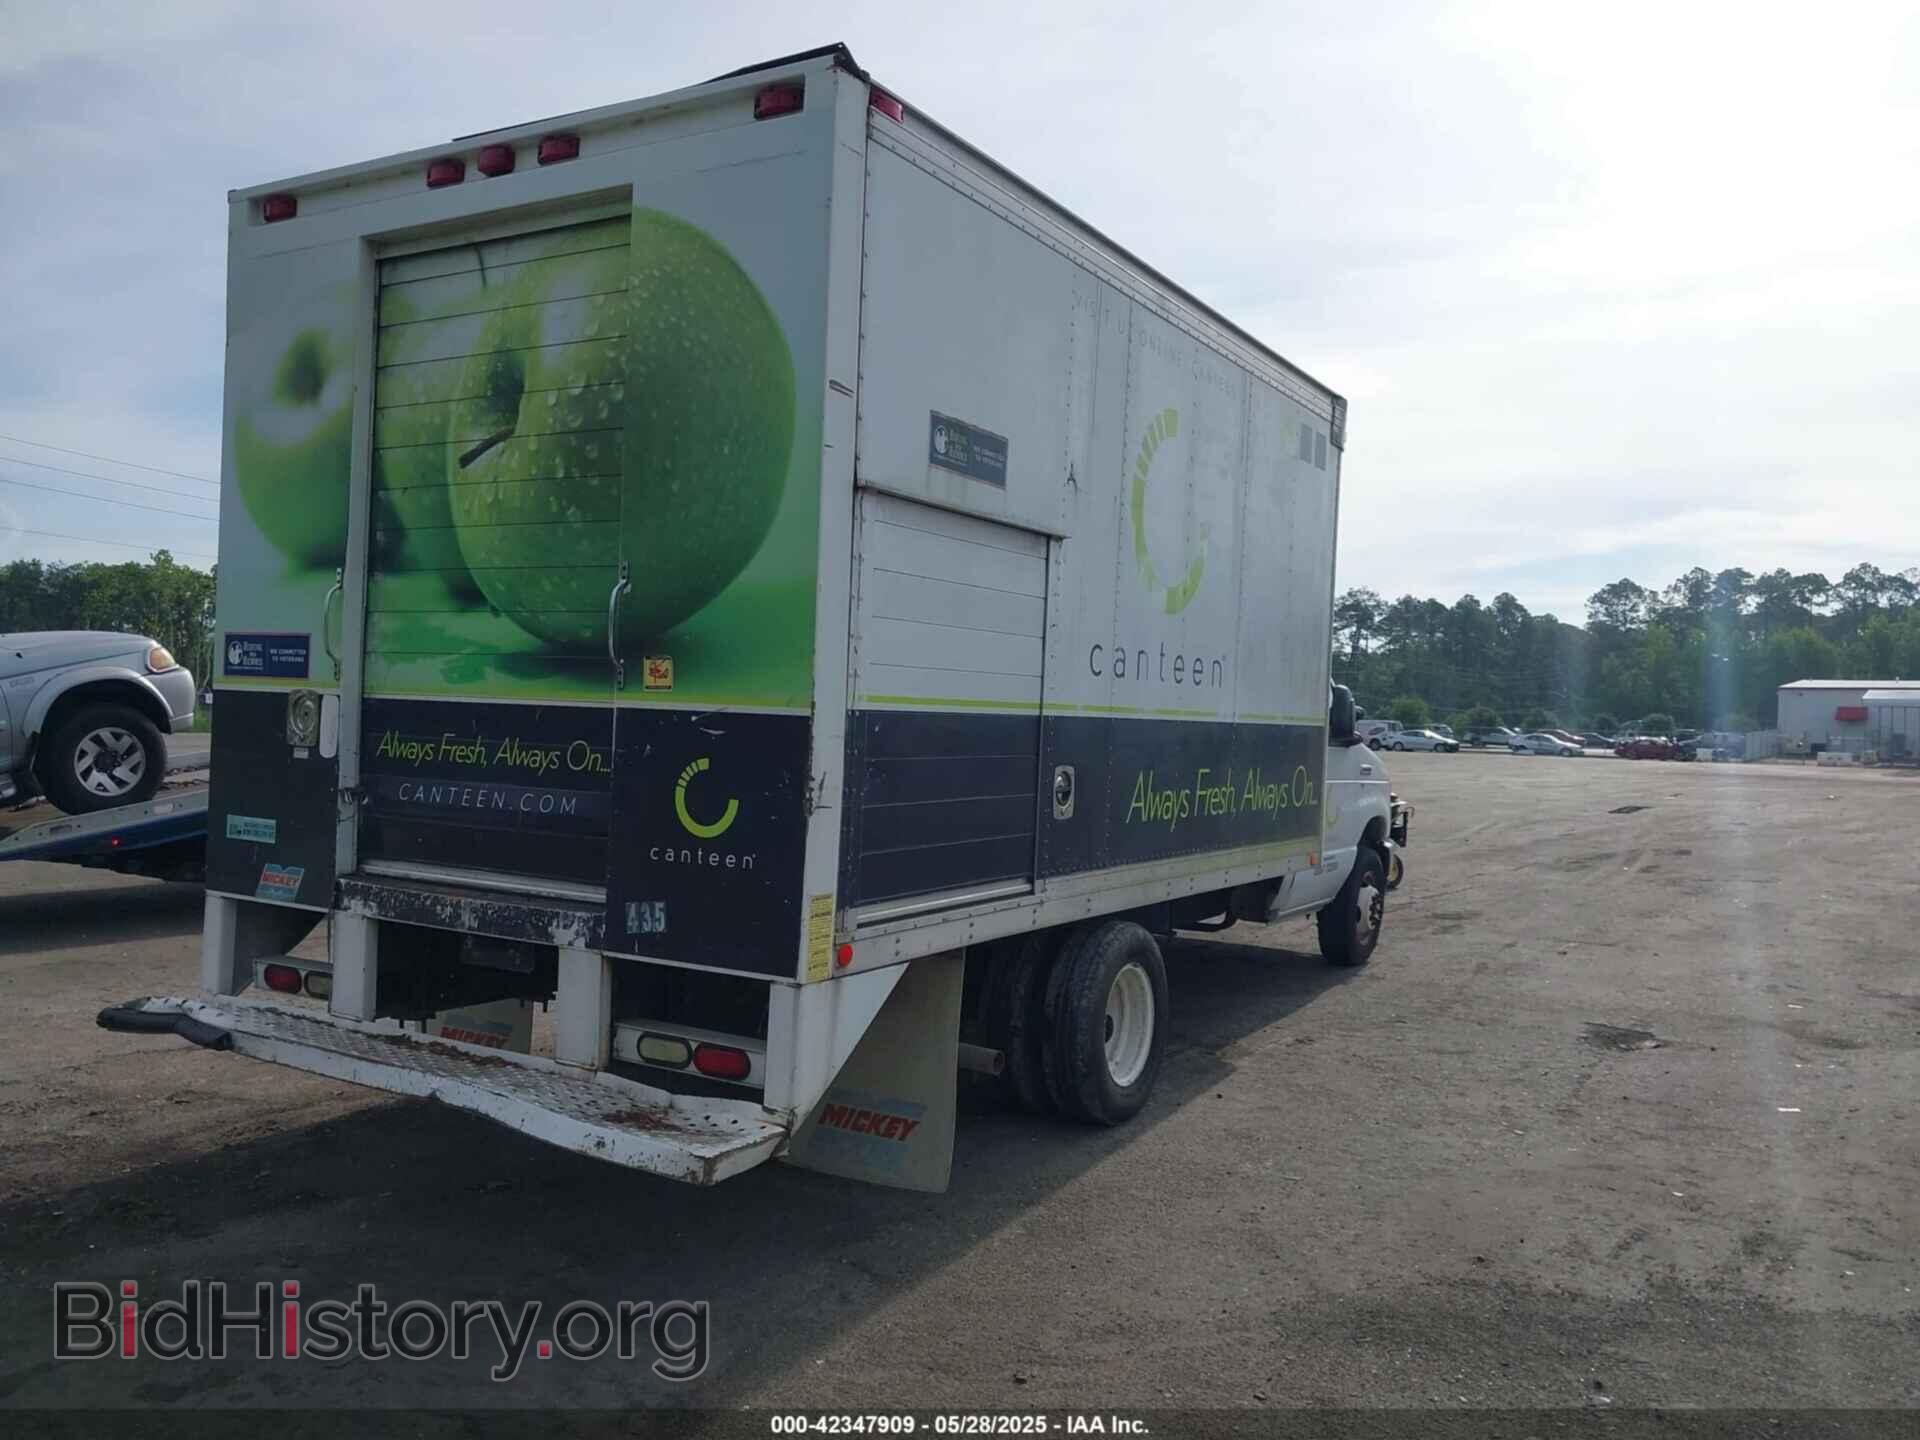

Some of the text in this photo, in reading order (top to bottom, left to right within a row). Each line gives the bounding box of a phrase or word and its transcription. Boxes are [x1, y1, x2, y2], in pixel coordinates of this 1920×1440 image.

[1090, 641, 1223, 689] canteen
[376, 731, 433, 767] Always
[438, 732, 487, 767] Fresh,
[493, 736, 561, 776] Always
[398, 782, 578, 816] CANTEEN.COM
[1126, 769, 1191, 832] Always
[1194, 767, 1237, 818] Fresh,
[1240, 767, 1289, 820] Always
[649, 846, 753, 870] canteen
[627, 902, 666, 934] 435
[817, 1103, 920, 1142] MICKEY
